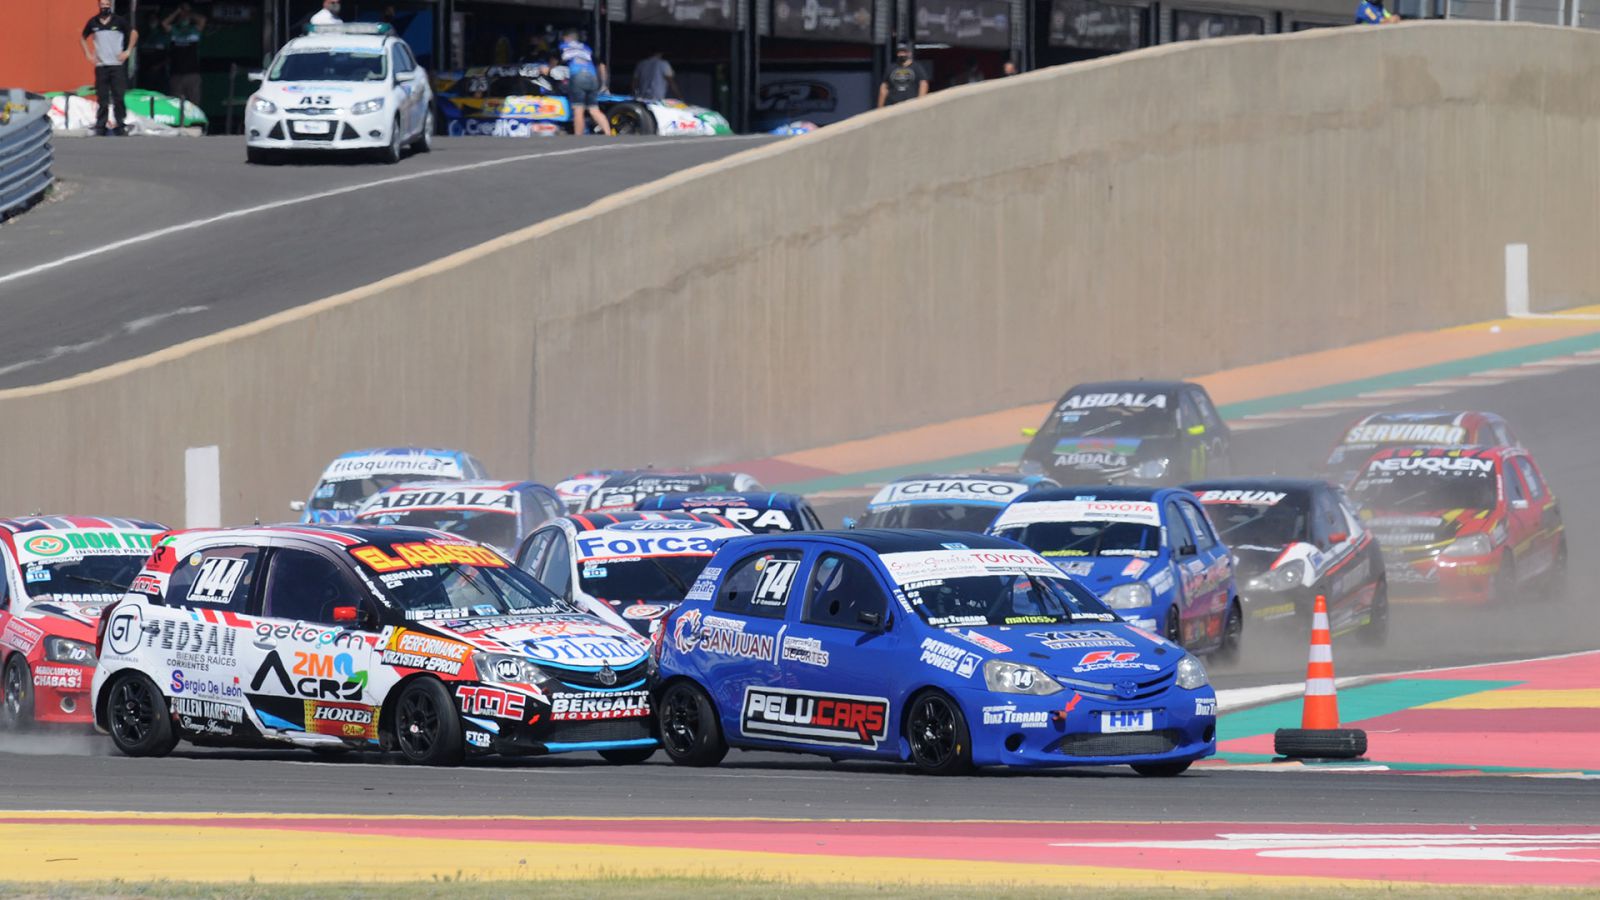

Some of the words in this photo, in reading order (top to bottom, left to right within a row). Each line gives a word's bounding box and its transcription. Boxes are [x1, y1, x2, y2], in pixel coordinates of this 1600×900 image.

[1059, 392, 1167, 411] ABDALA
[1054, 453, 1127, 467] ABDALA
[901, 482, 1014, 496] CHACO
[1200, 490, 1287, 502] BRUN
[368, 491, 513, 508] ABDALA
[1087, 503, 1153, 511] TOYOTA
[631, 520, 693, 529] Ford
[66, 533, 121, 549] DON
[971, 553, 1049, 566] TOYOTA
[194, 560, 244, 596] 144
[379, 569, 434, 583] BERGALLO
[757, 562, 797, 600] 14
[256, 619, 364, 650] getcom
[69, 648, 86, 660] 10
[399, 634, 468, 659] PERFORMANCE
[920, 637, 967, 660] PATRIOT
[176, 652, 204, 663] BIENES
[293, 651, 333, 678] 2M
[920, 650, 958, 672] POWER
[499, 662, 518, 676] 144
[170, 670, 206, 694] Sergio
[208, 680, 219, 693] De
[1013, 671, 1033, 687] 14
[456, 686, 526, 720] TMC
[314, 707, 372, 724] HOREB
[1005, 710, 1048, 723] TERRADO
[1110, 712, 1144, 727] HM
